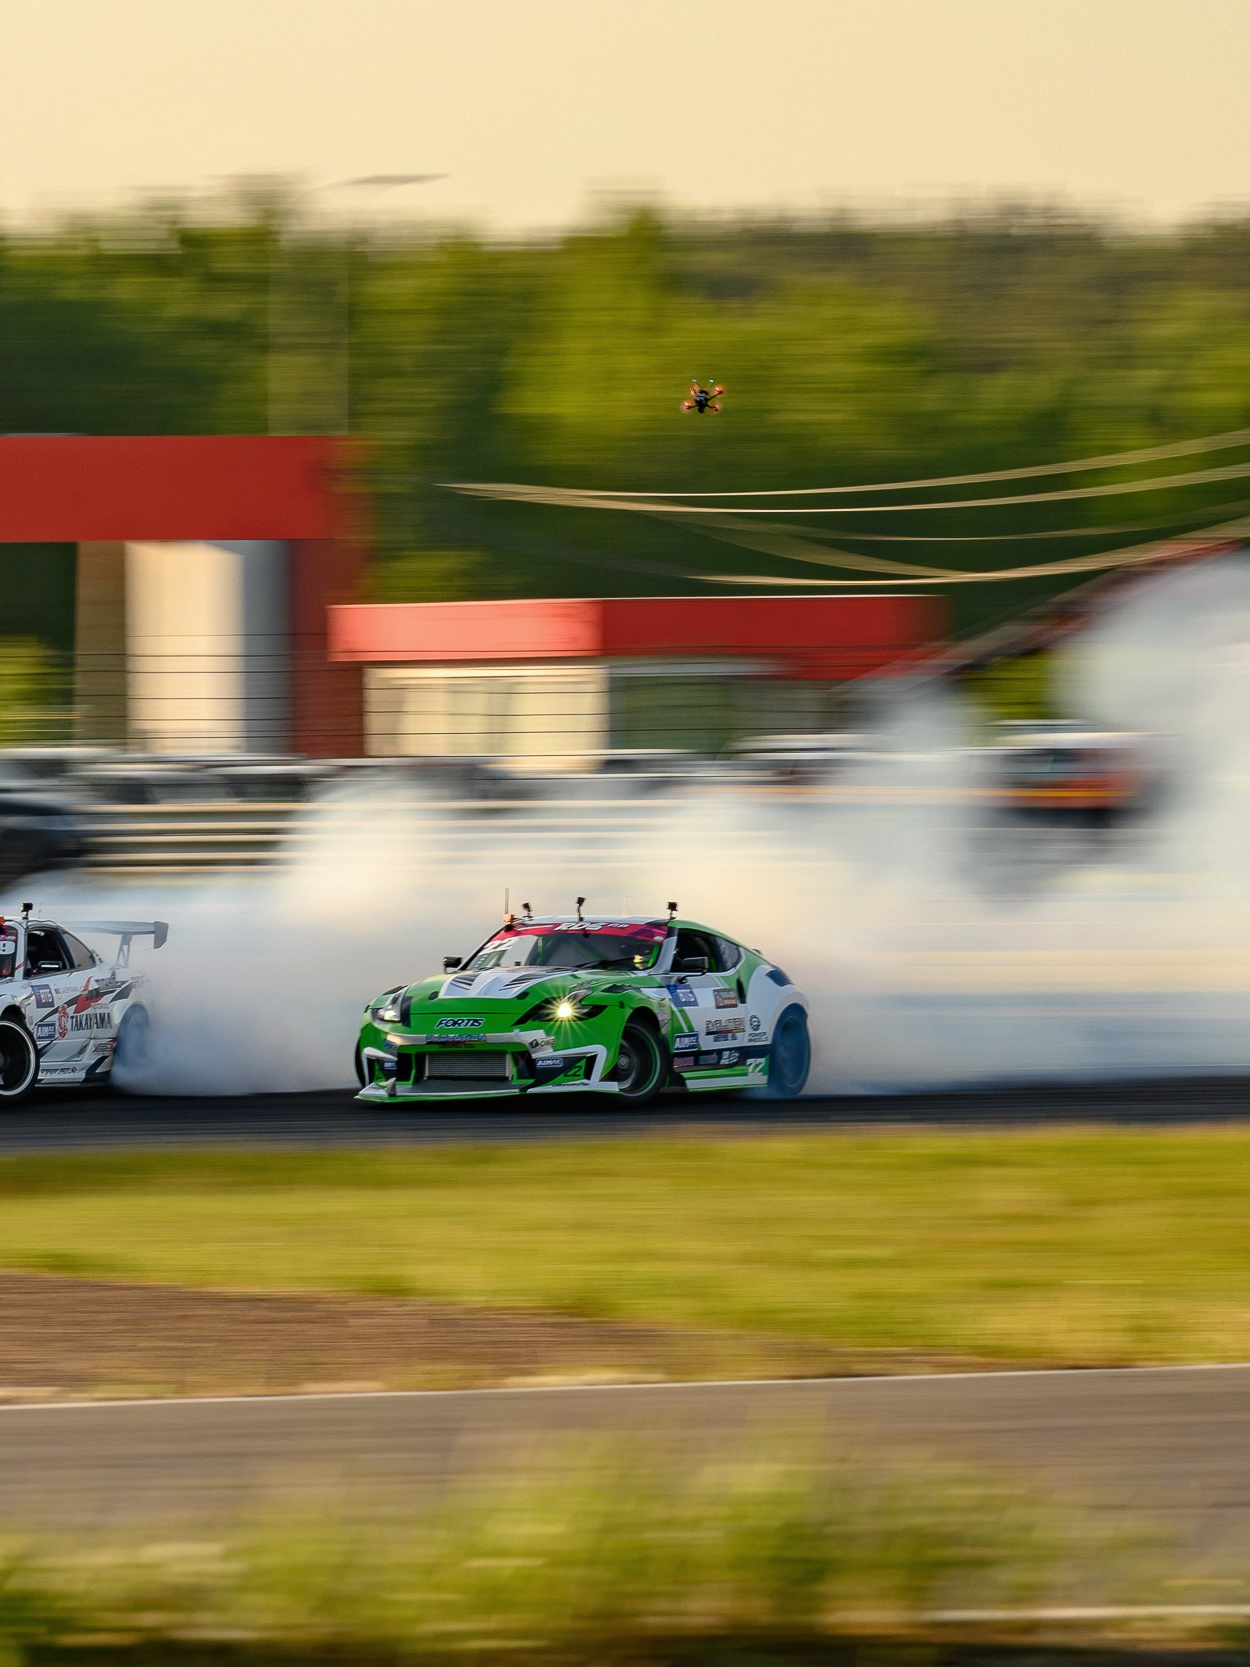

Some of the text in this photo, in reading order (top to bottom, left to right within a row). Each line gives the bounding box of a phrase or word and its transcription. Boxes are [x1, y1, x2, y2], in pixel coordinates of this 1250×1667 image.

[554, 922, 608, 931] RDS
[70, 1012, 113, 1032] TAKAYAMA
[436, 1018, 485, 1028] FORTIS
